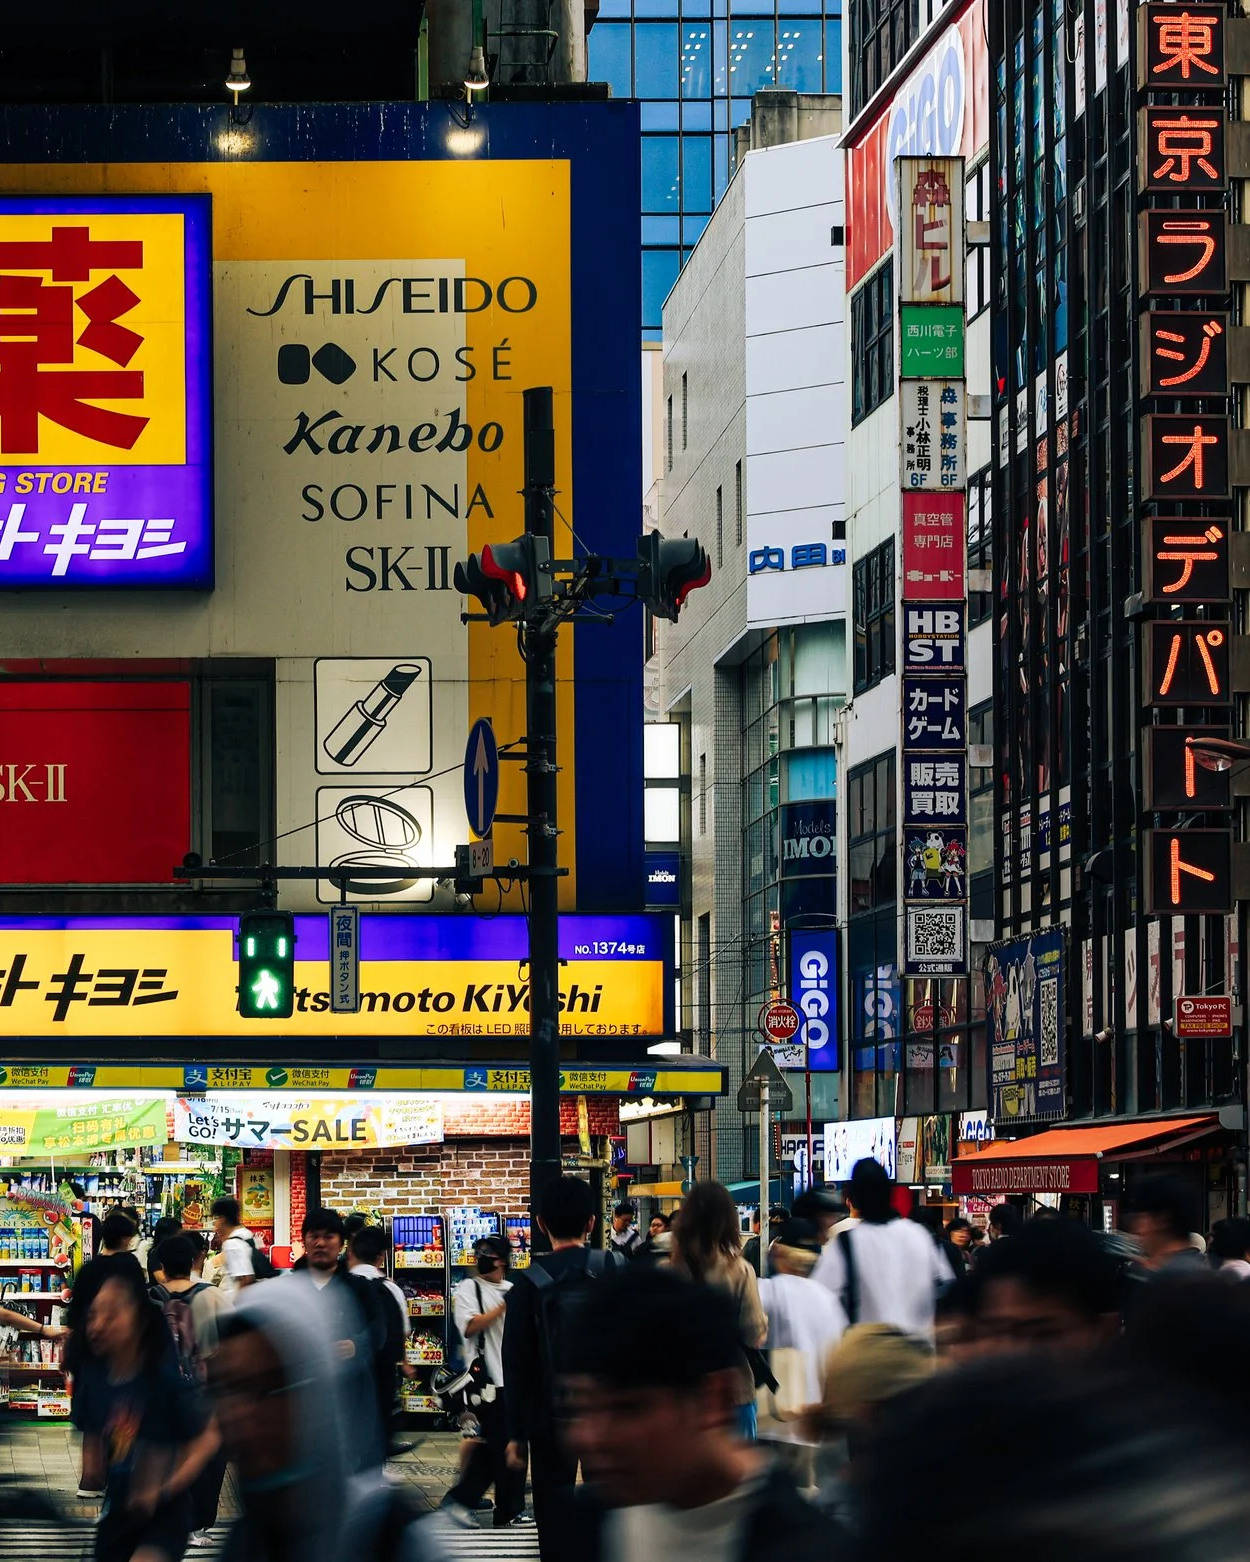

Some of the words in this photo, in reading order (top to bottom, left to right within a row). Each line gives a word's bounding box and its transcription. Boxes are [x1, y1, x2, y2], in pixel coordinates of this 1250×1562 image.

[911, 169, 952, 292] 森ビル
[246, 274, 537, 317] SHISEIDO
[907, 324, 957, 338] 西川電子
[373, 339, 512, 382] KOSÉ
[907, 346, 957, 359] パーツ部
[283, 407, 504, 455] Kanebo
[940, 386, 957, 471] 森事務所
[15, 472, 108, 494] STORE
[911, 472, 927, 486] 6F
[941, 472, 957, 485] 6F
[302, 483, 494, 522] SOFINA
[913, 512, 953, 527] 真空管
[913, 535, 953, 548] 専門店
[749, 543, 826, 575] 内田
[345, 546, 453, 592] SK-II
[908, 611, 959, 633] HB
[908, 640, 959, 662] ST
[909, 688, 959, 711] カード
[908, 716, 961, 740] ゲーム
[911, 762, 959, 786] 販売
[911, 792, 959, 815] 買取
[794, 820, 831, 837] Models
[473, 848, 490, 869] 8-20
[648, 875, 676, 883] IMON
[336, 915, 352, 948] 夜間
[574, 942, 645, 954] NO.1374号店
[918, 963, 953, 972] 公式通販
[339, 951, 350, 1004] 押ボタン式
[462, 985, 603, 1013] KiYshi
[799, 950, 829, 1049] GiGO
[426, 1024, 482, 1035] この看板は
[487, 1024, 511, 1034] LED
[768, 1015, 796, 1029] 消火栓
[11, 1068, 48, 1077] 微信支付
[211, 1069, 251, 1080] 支付宝
[292, 1069, 330, 1079] 微信支付
[569, 1072, 606, 1081] 微信支付
[57, 1105, 97, 1117] 微信支付
[188, 1113, 219, 1127] Let's
[72, 1117, 126, 1134] 扫码有礼
[188, 1125, 216, 1139] GO!
[972, 1168, 990, 1190] TOKYO
[991, 1167, 1008, 1189] RADIO
[1009, 1166, 1049, 1189] DEPARTMENT
[1050, 1165, 1070, 1188] STORE
[423, 1351, 442, 1360] 228
